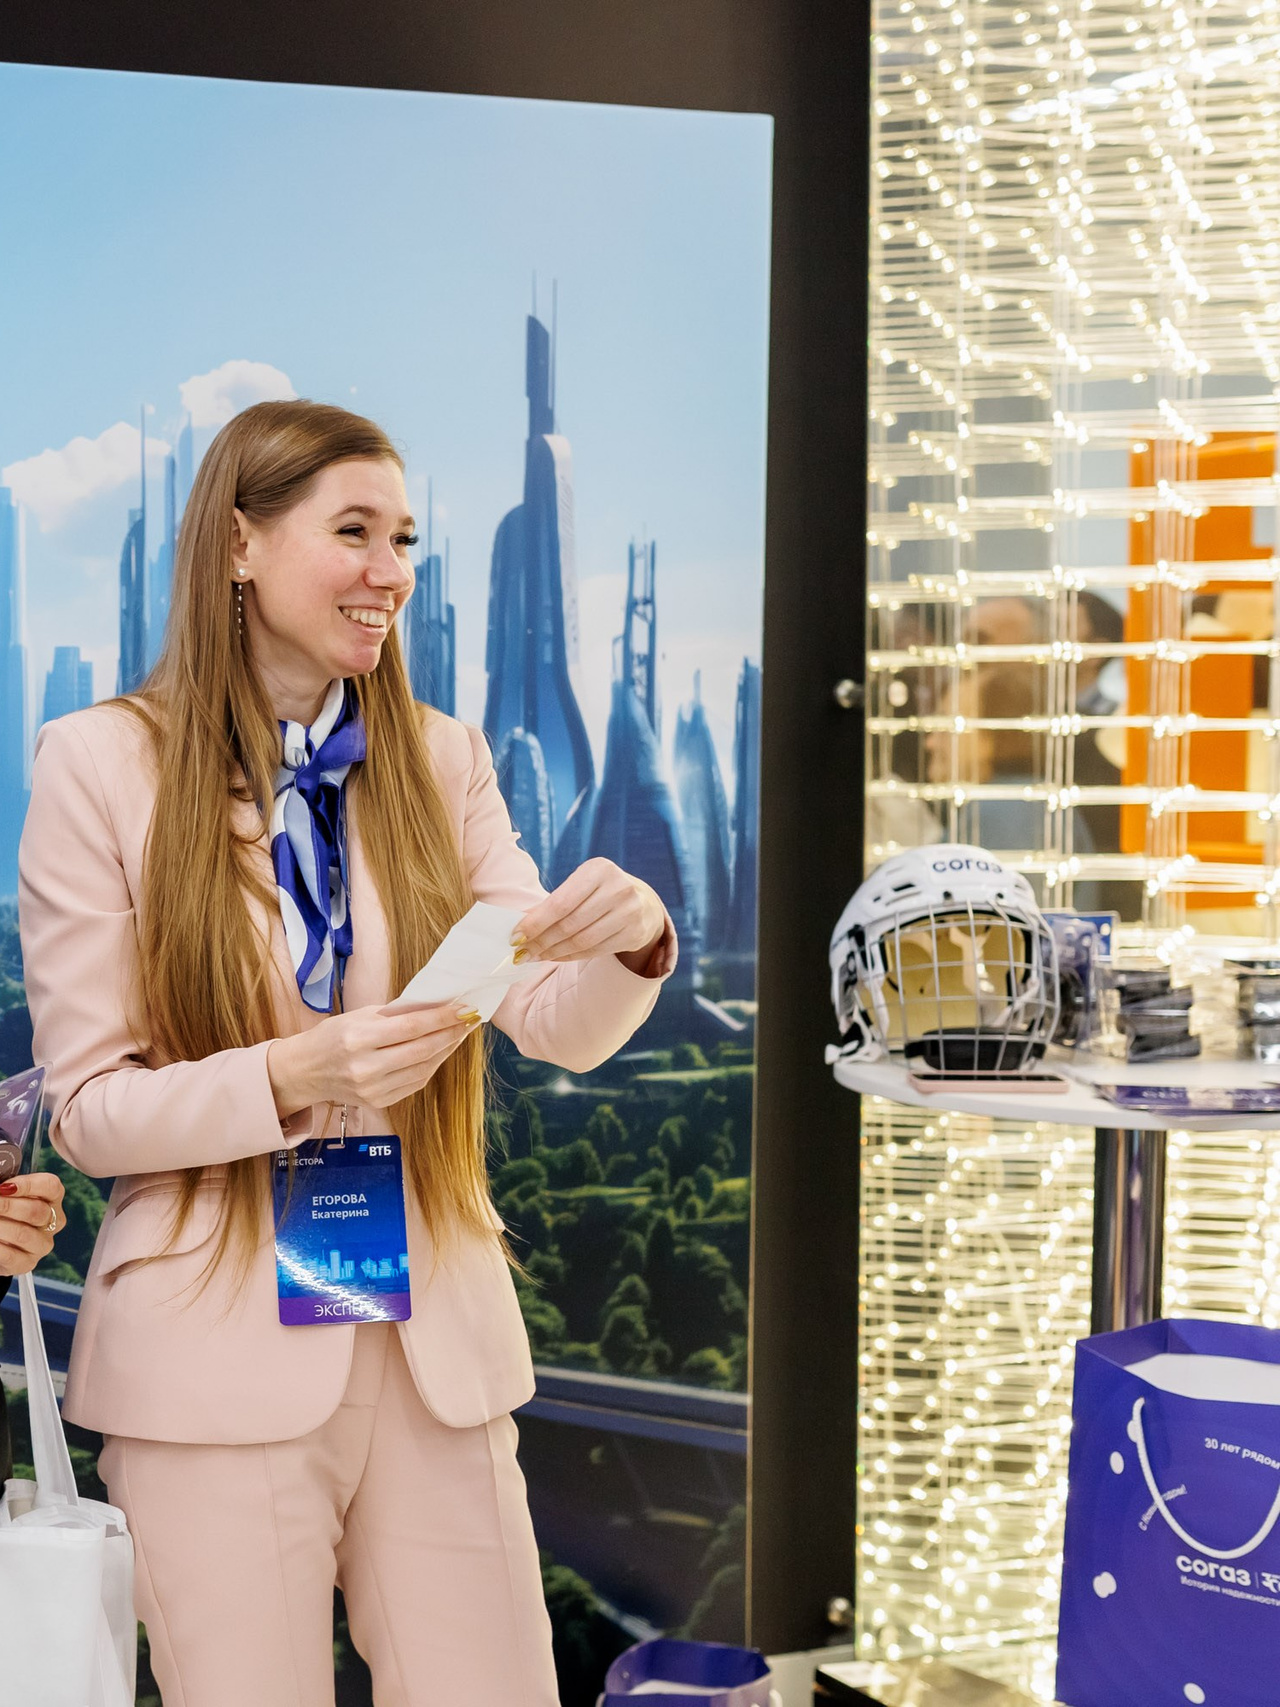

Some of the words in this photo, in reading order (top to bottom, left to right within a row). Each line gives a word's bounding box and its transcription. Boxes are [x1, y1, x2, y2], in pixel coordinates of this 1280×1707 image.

[278, 1150, 298, 1159] ДЕЬ
[369, 1145, 392, 1157] ВТБ
[278, 1158, 324, 1167] ИНЕСТОРА
[312, 1194, 367, 1207] ЕГОРОВА
[311, 1208, 369, 1220] Екатерина
[314, 1302, 371, 1317] ЭКСПЕ
[1204, 1437, 1218, 1450] 30
[1220, 1442, 1241, 1455] лет
[1242, 1448, 1280, 1470] рядом
[1176, 1555, 1251, 1586] согаз
